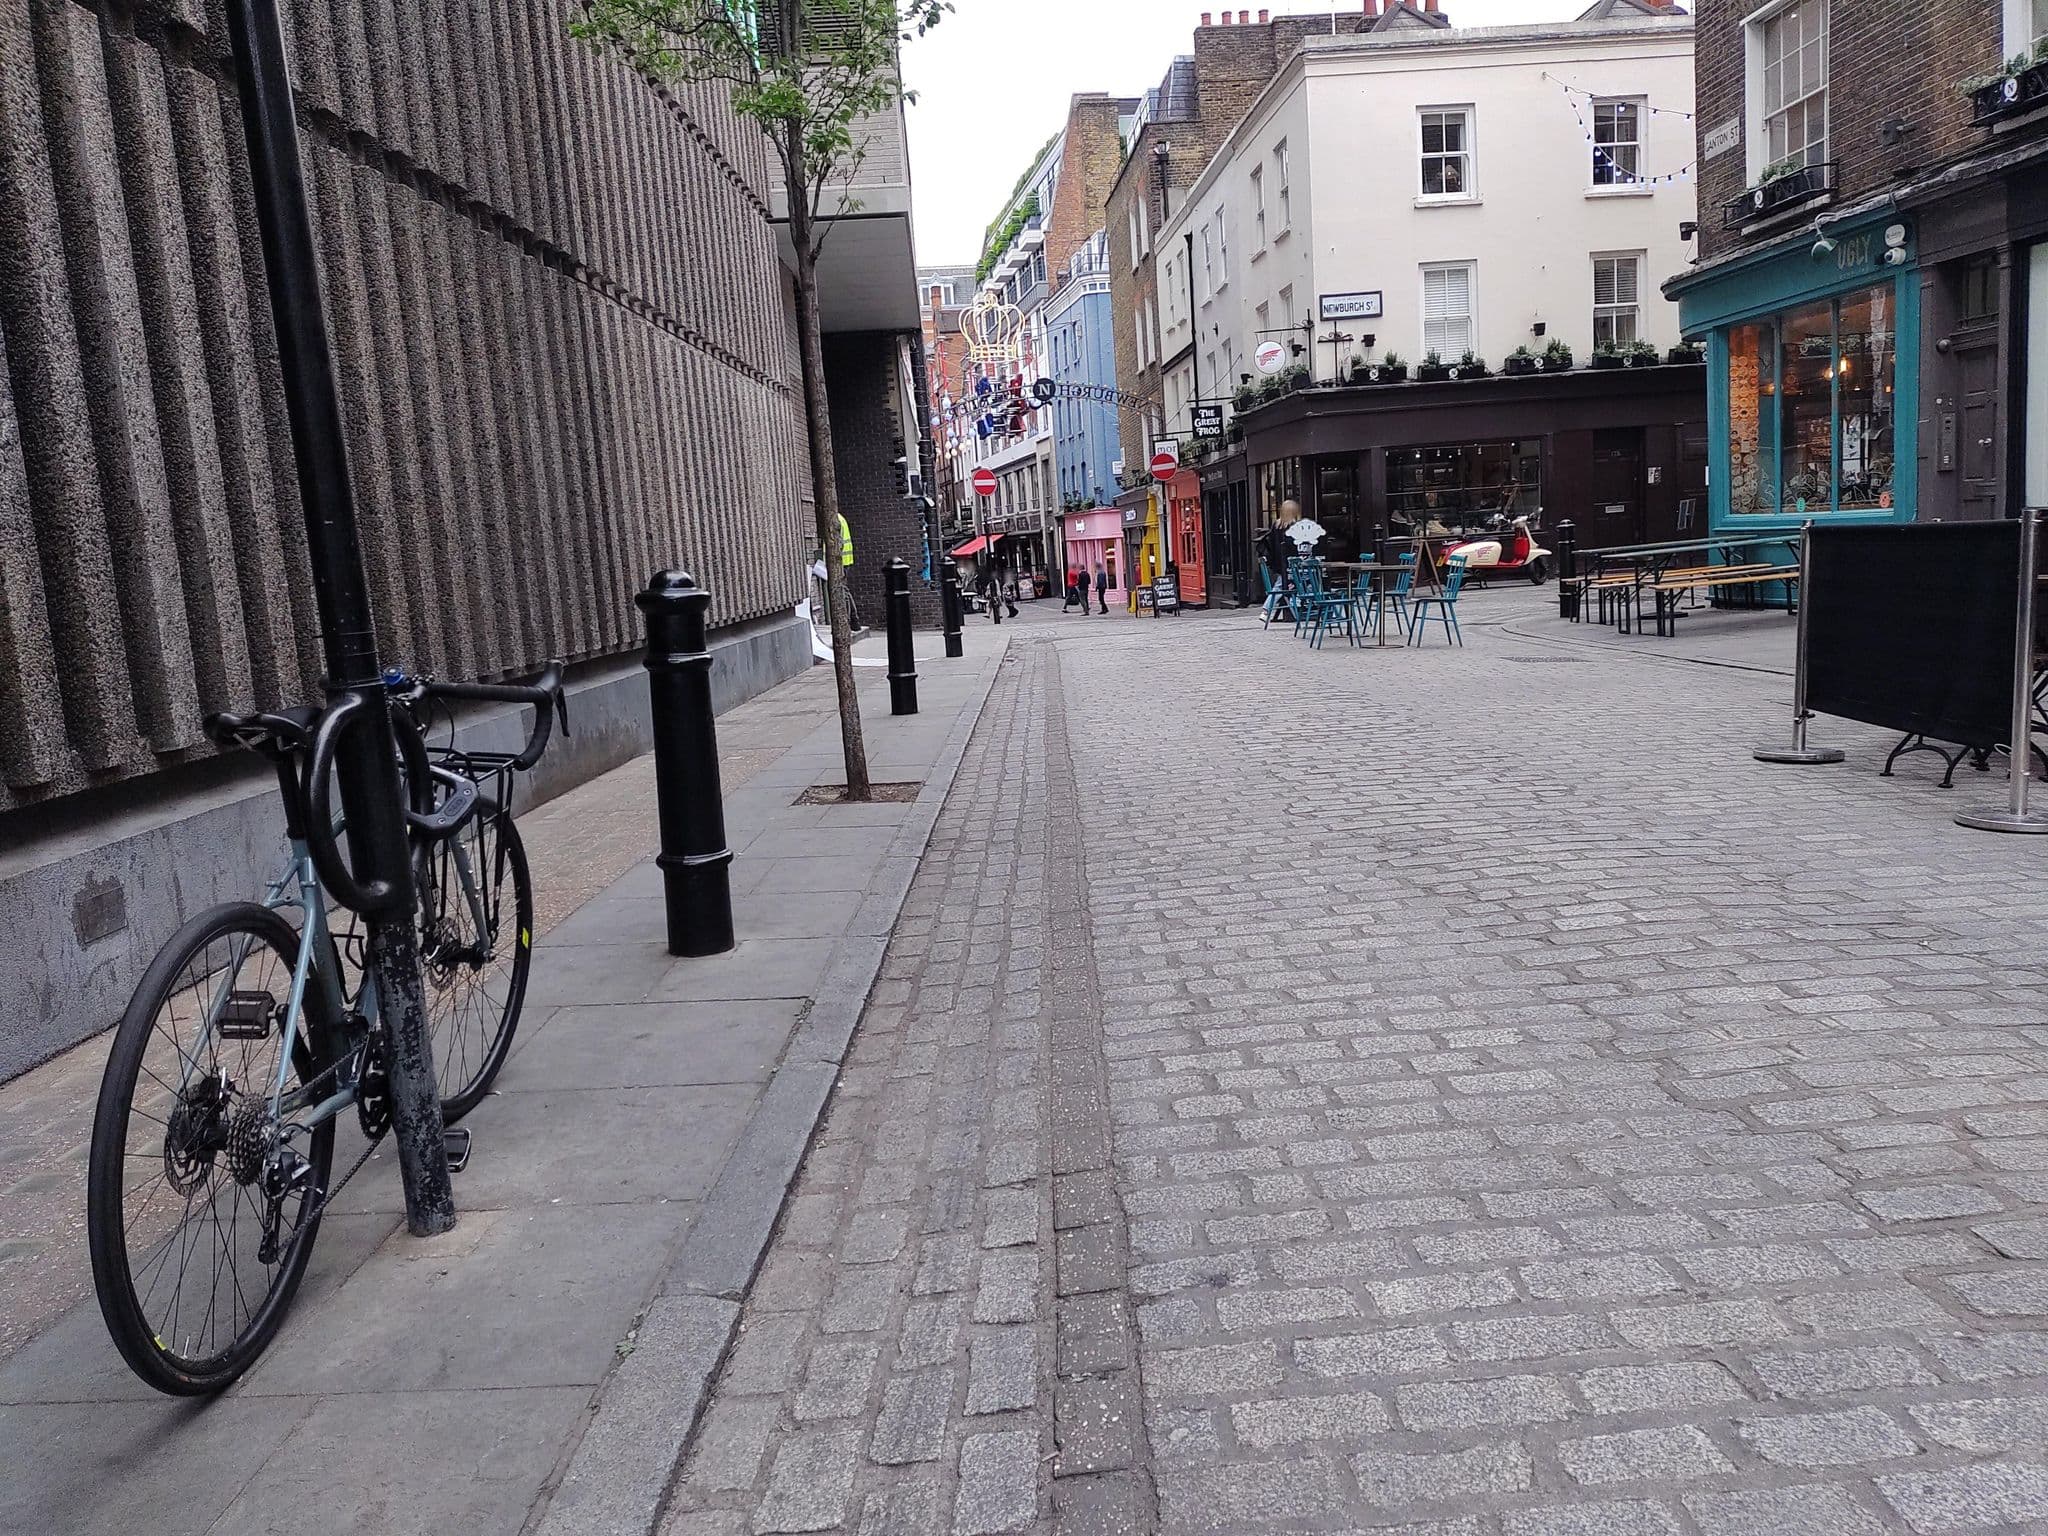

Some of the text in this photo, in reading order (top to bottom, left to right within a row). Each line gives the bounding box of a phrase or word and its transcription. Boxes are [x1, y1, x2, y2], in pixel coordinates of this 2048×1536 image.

[1838, 233, 1872, 270] UGLY
[1198, 409, 1216, 418] THE
[1194, 417, 1221, 428] GREAT
[1196, 427, 1221, 437] FROG
